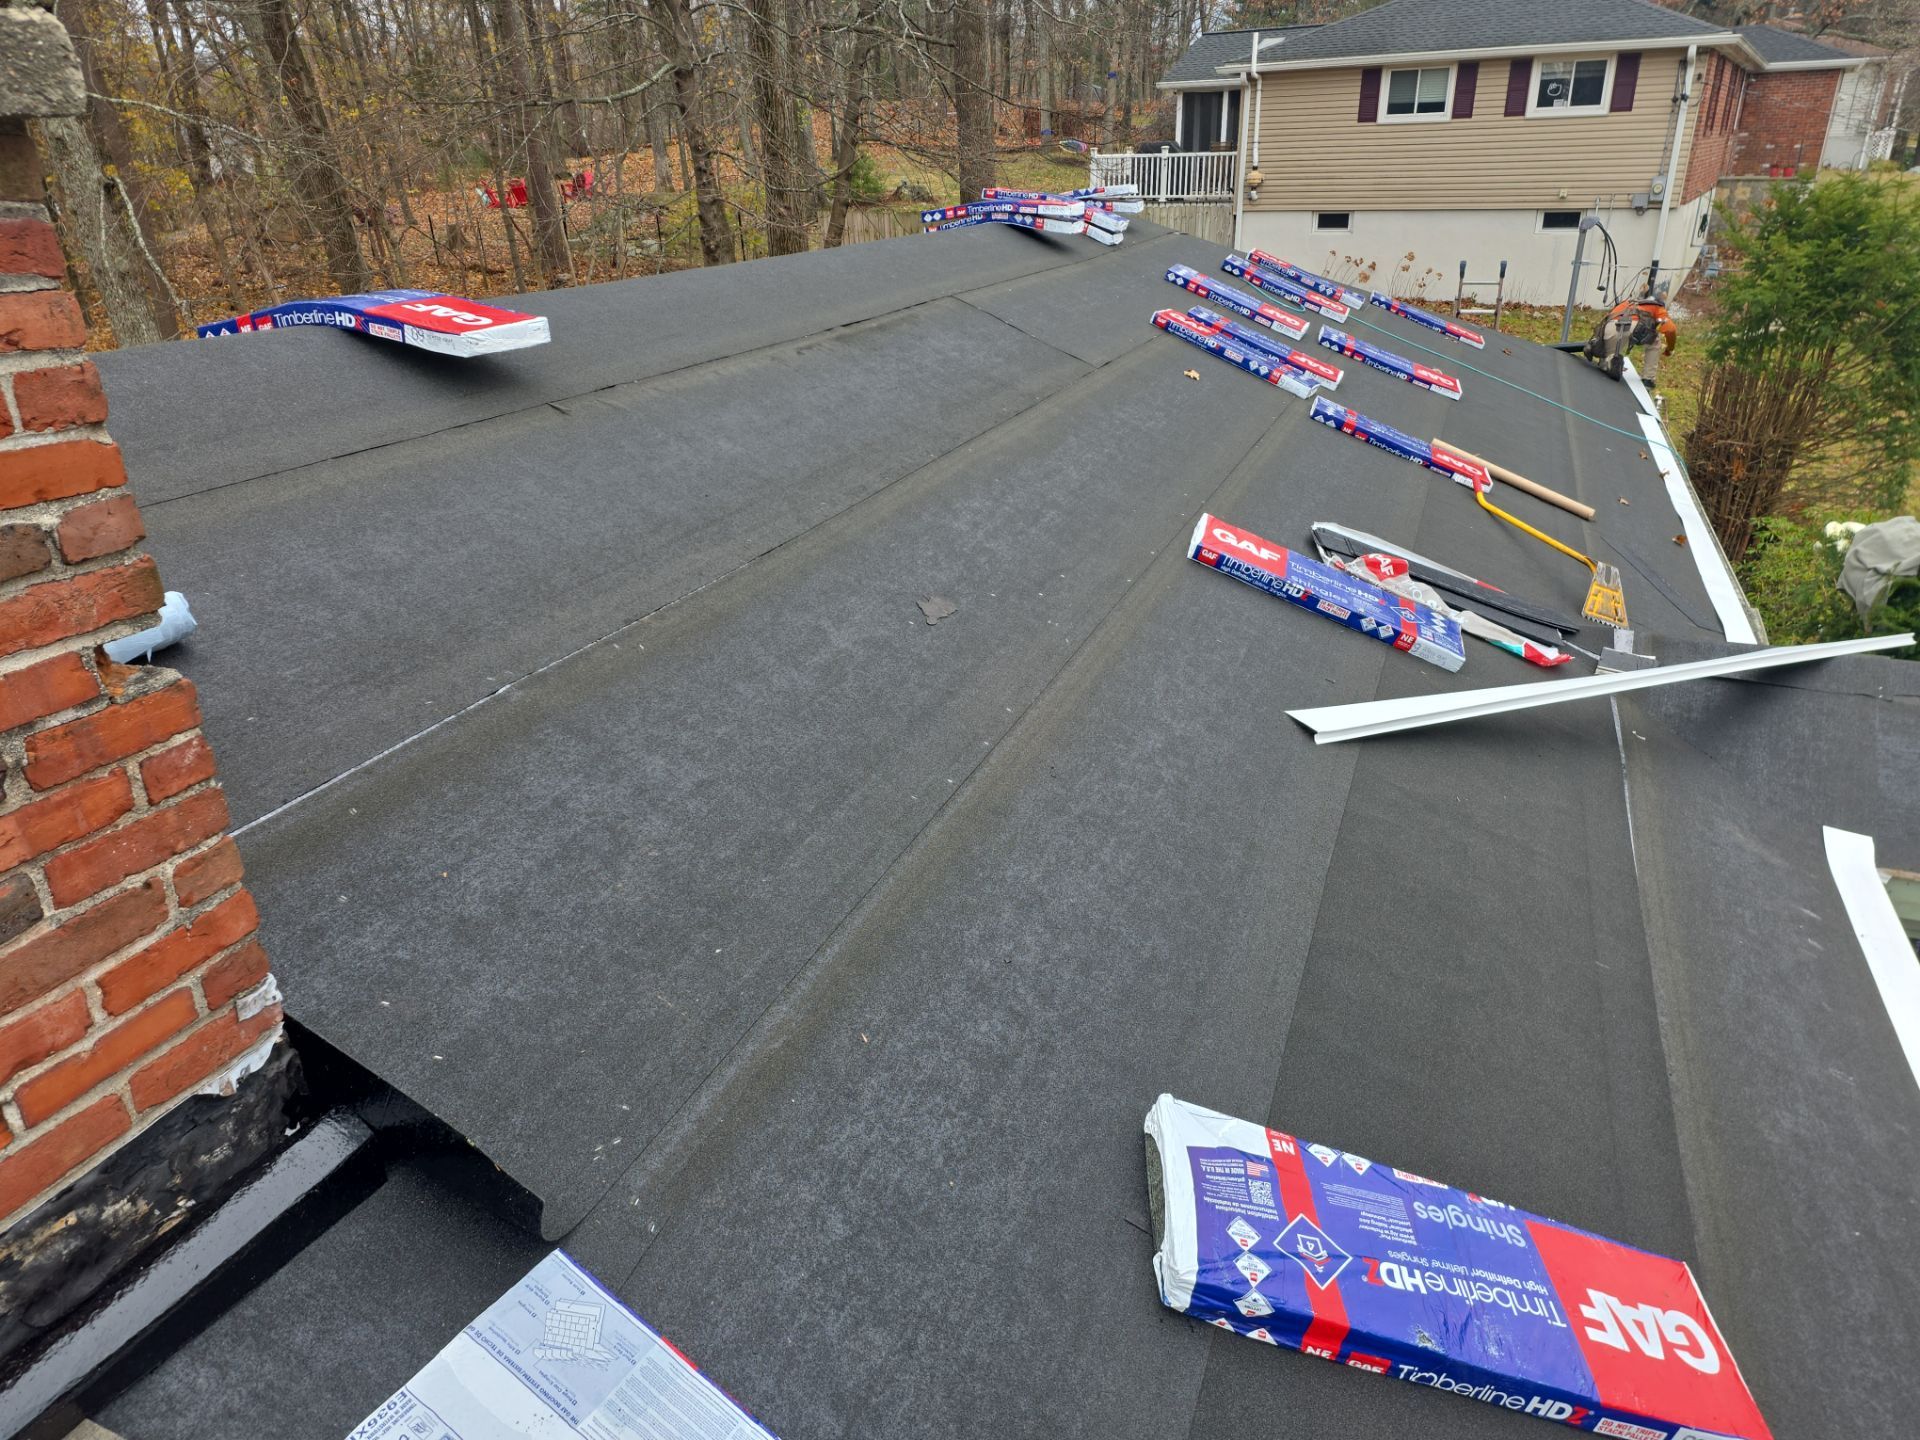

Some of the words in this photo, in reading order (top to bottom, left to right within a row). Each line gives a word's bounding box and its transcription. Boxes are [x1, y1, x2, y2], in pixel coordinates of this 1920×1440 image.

[1212, 528, 1280, 561] GAF
[1201, 549, 1218, 560] GAF
[1400, 633, 1415, 644] NE
[1273, 1139, 1296, 1156] NE
[1413, 1201, 1528, 1248] Shingles
[1387, 1250, 1429, 1267] Shingles
[1522, 1280, 1549, 1296] High
[1579, 1287, 1720, 1375] GAF
[1599, 1426, 1623, 1435] STACK
[1602, 1419, 1614, 1427] DO
[1616, 1423, 1633, 1431] NOT
[1636, 1428, 1665, 1439] TRIPLE
